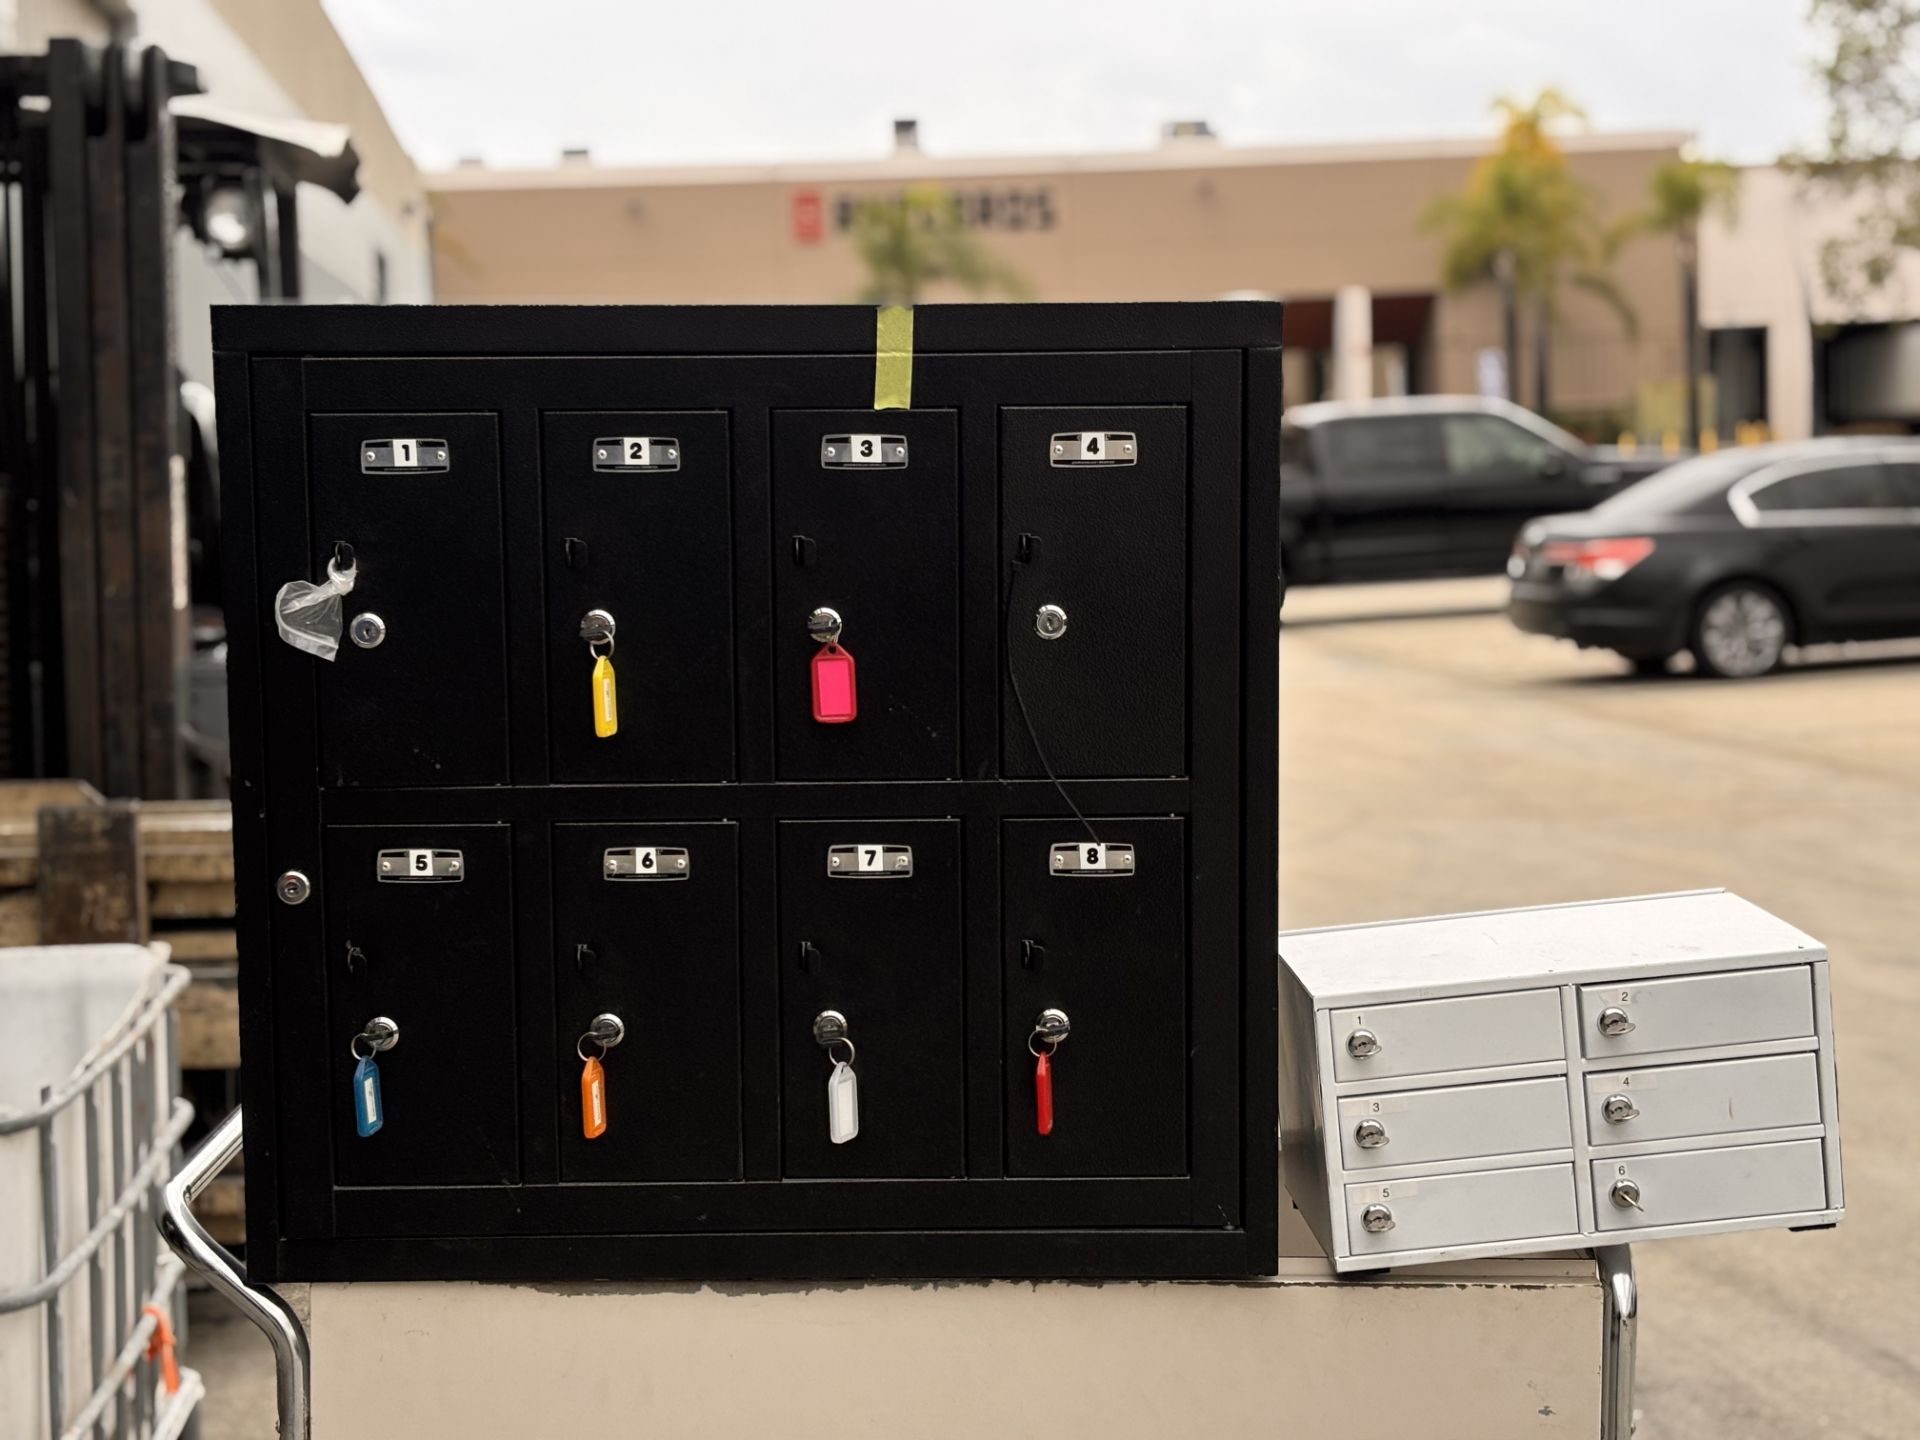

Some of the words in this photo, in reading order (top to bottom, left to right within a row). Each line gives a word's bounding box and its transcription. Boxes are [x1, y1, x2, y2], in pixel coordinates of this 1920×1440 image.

[401, 444, 410, 462] 1
[629, 442, 643, 460] 2
[860, 439, 873, 457] 3
[1086, 437, 1100, 455] 4
[415, 854, 428, 872] 5
[641, 851, 654, 869] 6
[864, 849, 877, 867] 7
[1086, 847, 1099, 865] 8
[1621, 991, 1629, 1002] 2
[1622, 1076, 1631, 1087] 4
[1372, 1102, 1380, 1113] 3
[1618, 1165, 1626, 1176] 6
[1382, 1187, 1390, 1198] 5
